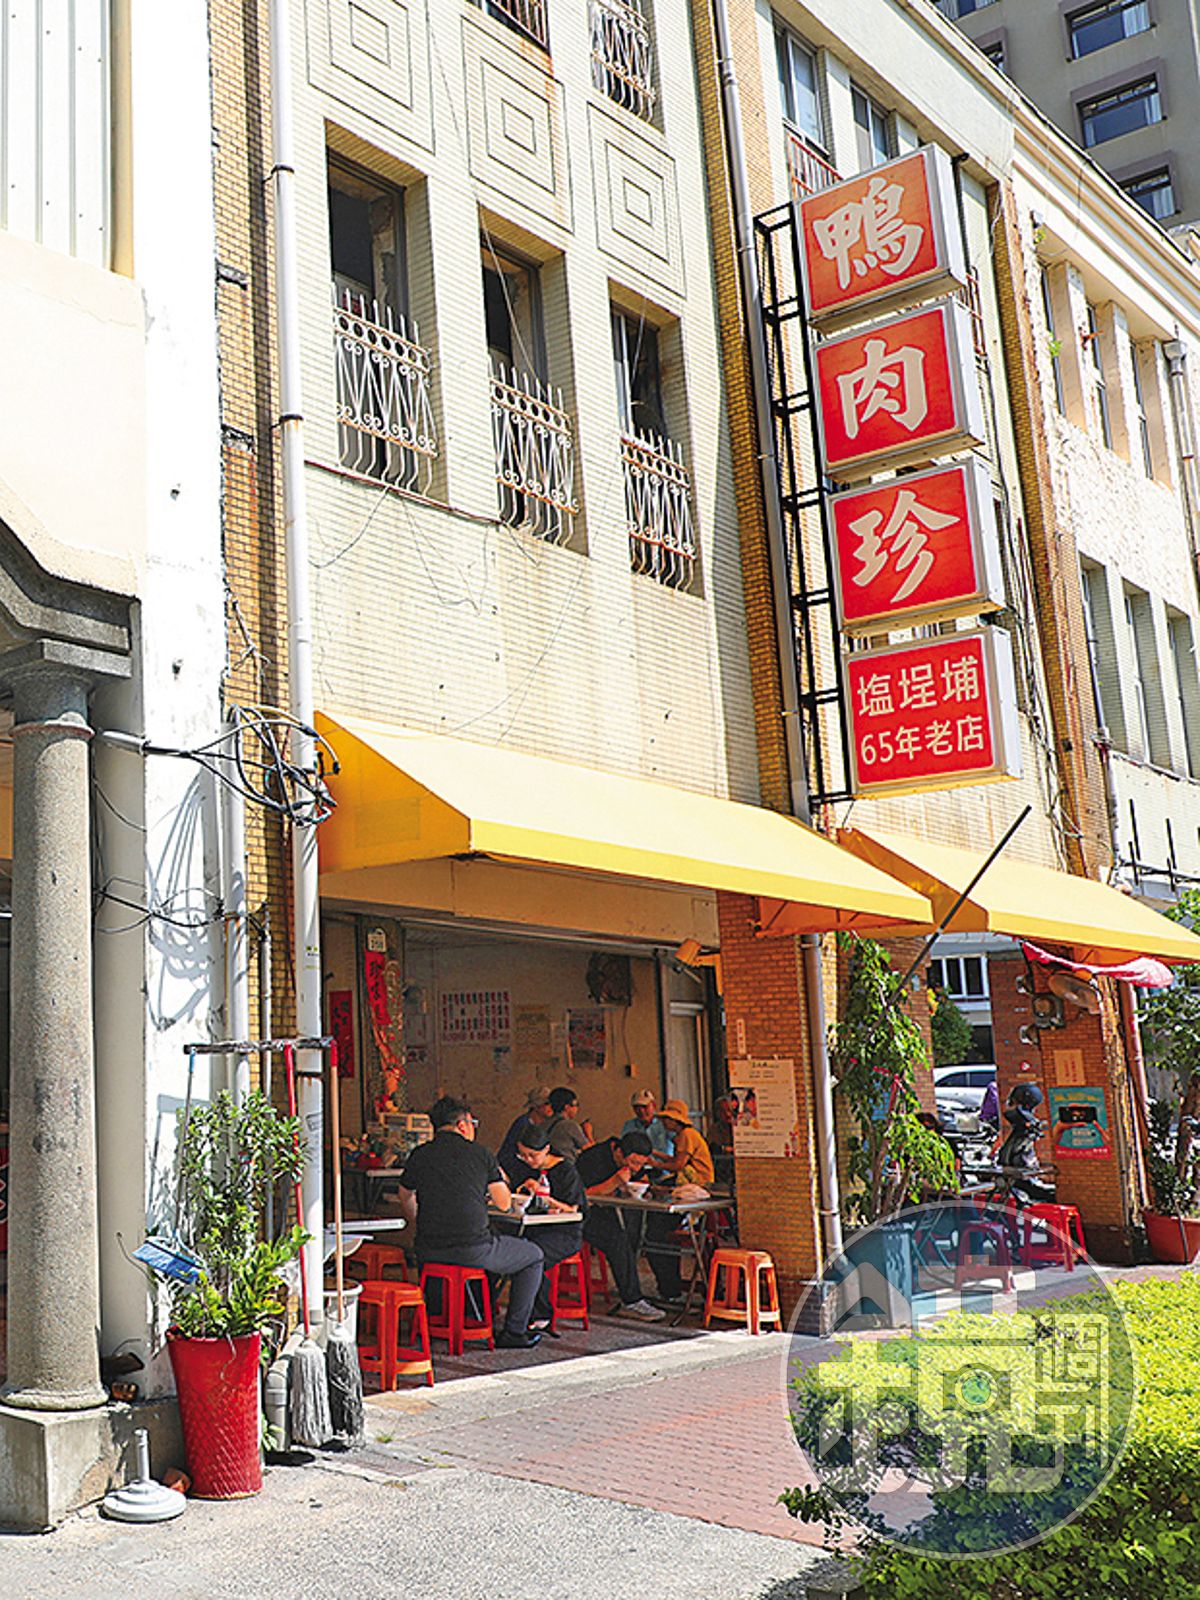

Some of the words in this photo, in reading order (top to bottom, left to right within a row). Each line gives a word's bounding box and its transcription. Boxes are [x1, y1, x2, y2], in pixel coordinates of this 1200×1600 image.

[812, 177, 962, 604] 鴨肉珍
[857, 655, 979, 716] 塩埕埔
[861, 714, 984, 765] 65年老店
